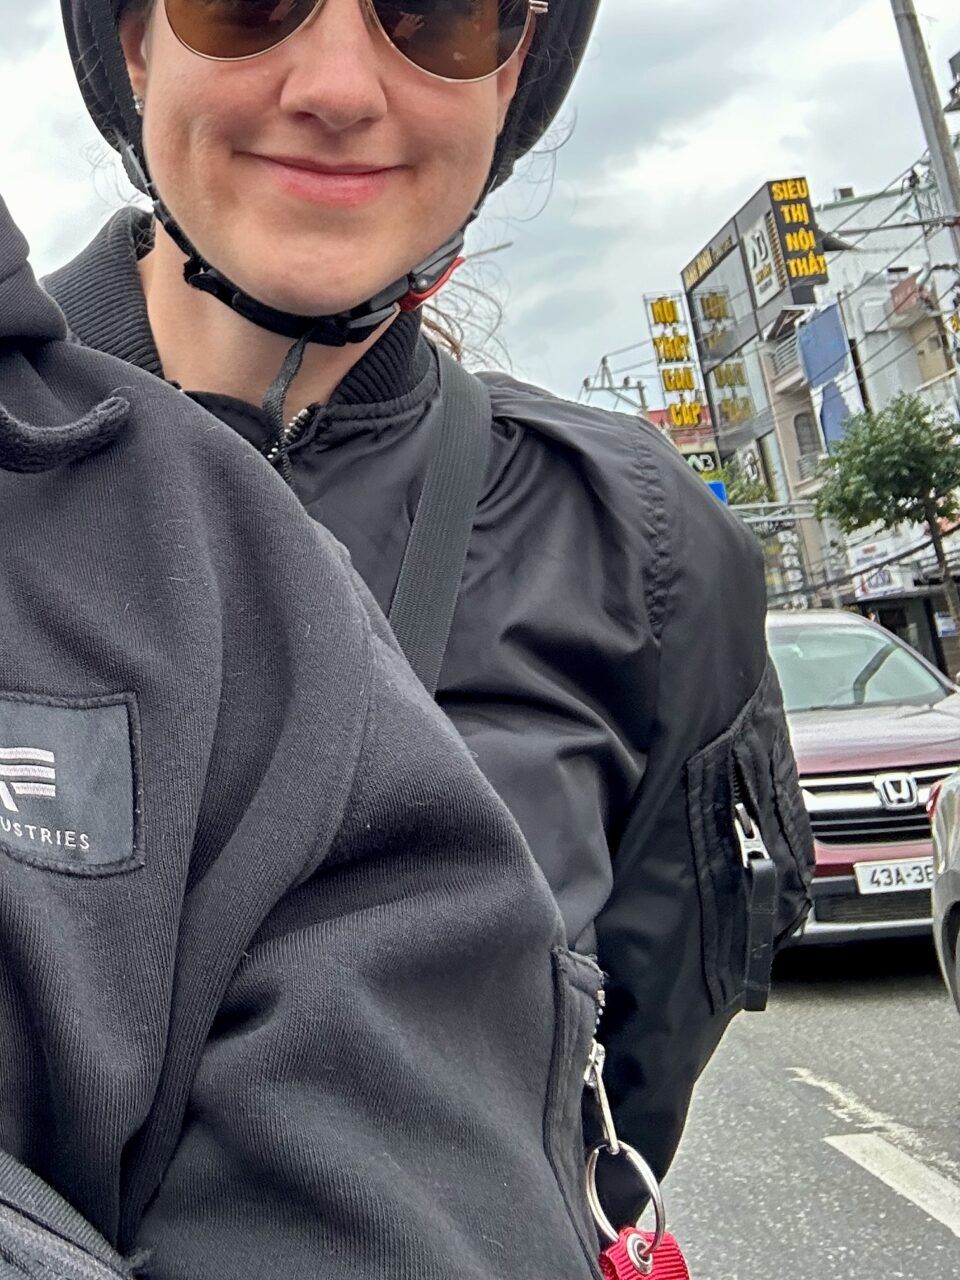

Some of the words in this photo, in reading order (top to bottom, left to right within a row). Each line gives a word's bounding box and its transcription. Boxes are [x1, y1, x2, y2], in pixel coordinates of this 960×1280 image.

[772, 178, 808, 201] SIÊU
[780, 203, 809, 225] THỊ
[785, 227, 816, 252] NỘI
